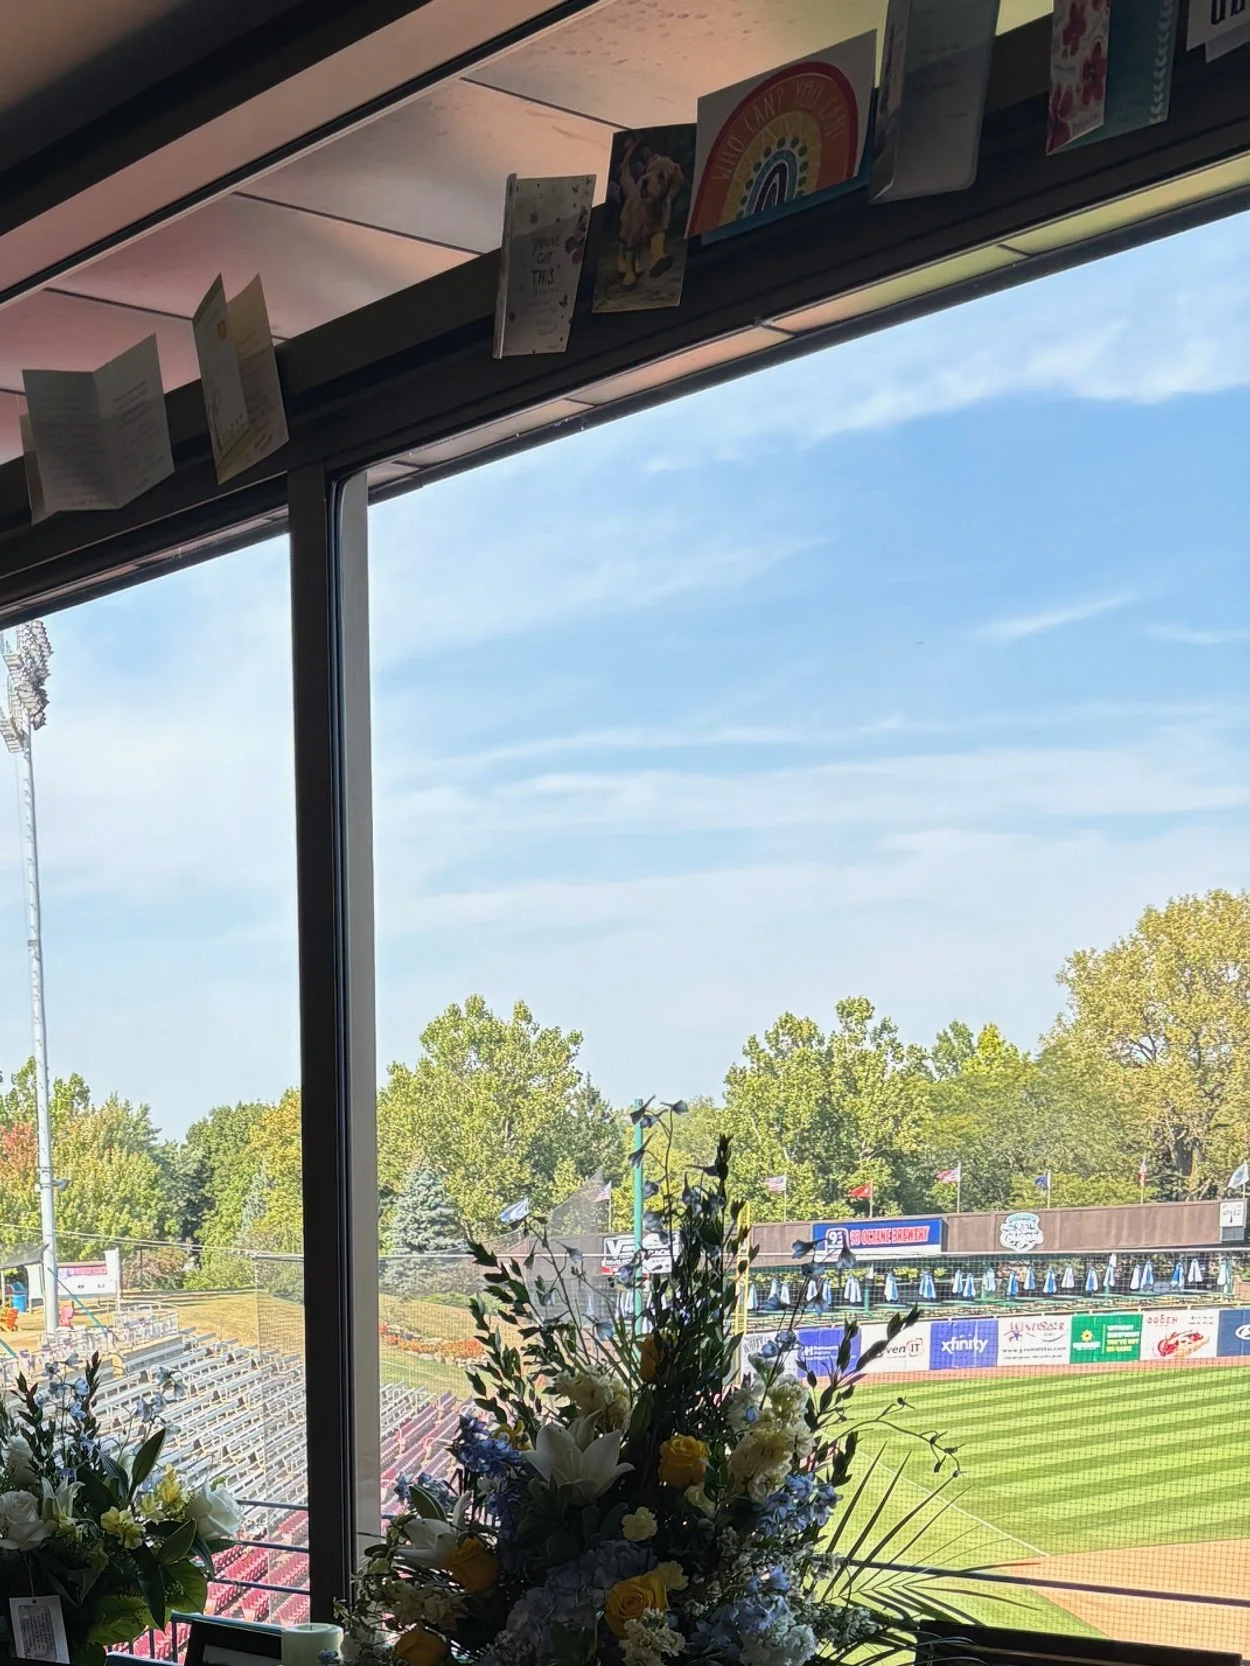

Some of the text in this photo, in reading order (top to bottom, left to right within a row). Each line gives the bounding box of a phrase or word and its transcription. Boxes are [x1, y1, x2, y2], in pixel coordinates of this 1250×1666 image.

[862, 1227, 892, 1245] OCTANE
[892, 1225, 930, 1243] BREWERY
[941, 1333, 988, 1354] xfinity
